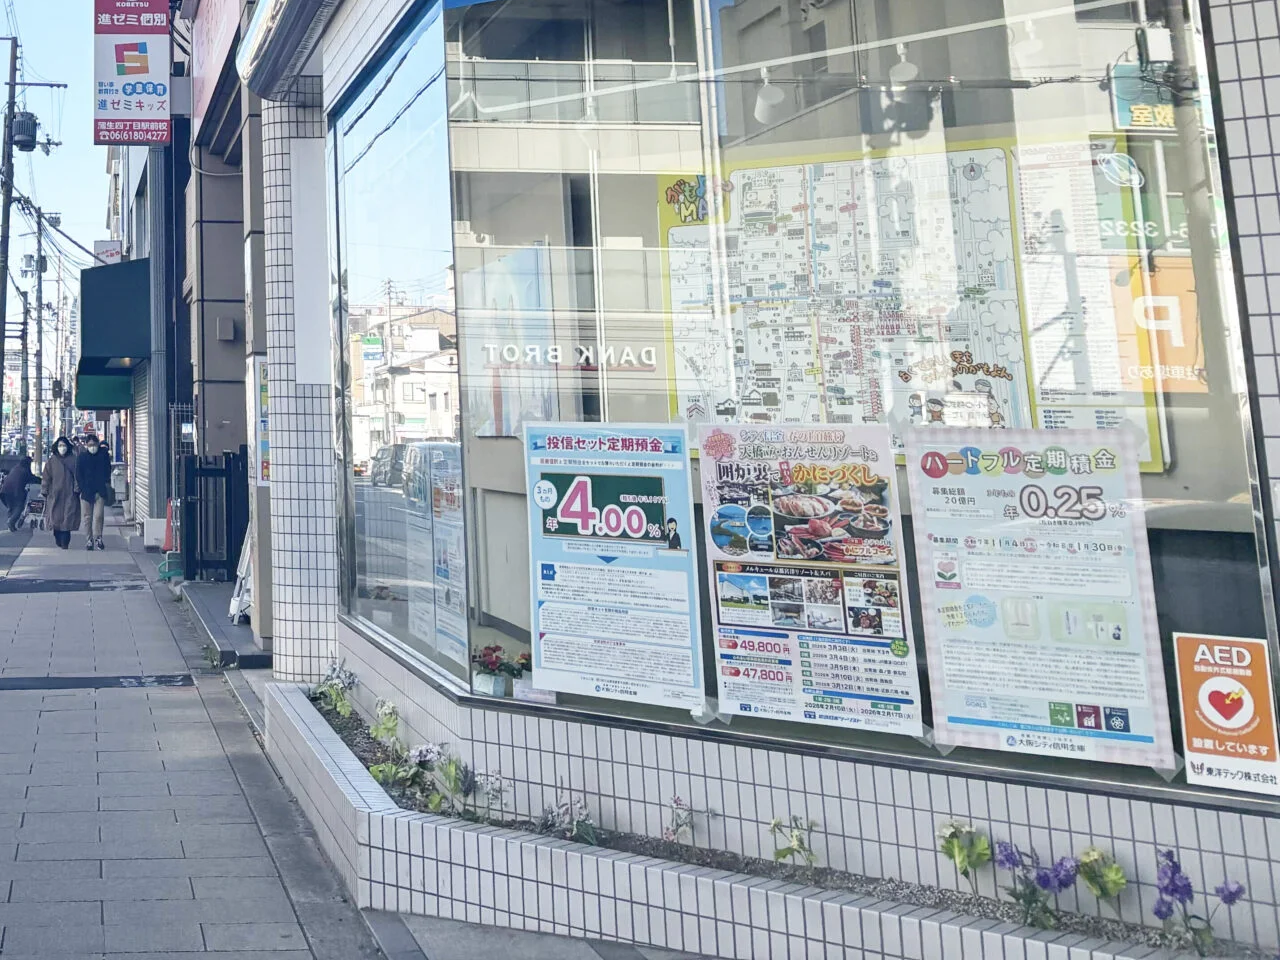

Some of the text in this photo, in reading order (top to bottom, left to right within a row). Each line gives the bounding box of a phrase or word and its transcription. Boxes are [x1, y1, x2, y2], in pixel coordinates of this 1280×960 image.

[97, 13, 167, 27] 進ゼミ個別
[97, 99, 167, 111] 進ゼミキッズ
[97, 121, 168, 130] 蒲生四丁目駅前校
[109, 131, 168, 141] 06(6180)4277
[546, 435, 664, 453] 投信セット定期預金
[738, 444, 878, 462] 天橋立・おんせんリゾートと
[925, 448, 1117, 475] ハートフル定期積金
[793, 464, 879, 486] かにづくし
[932, 487, 966, 497] 募集総額
[944, 496, 976, 506] 20億円
[546, 476, 661, 538] 年 4.00 %
[1003, 505, 1020, 520] 年
[1019, 484, 1108, 522] 0.25
[1194, 643, 1252, 667] AED
[1191, 737, 1270, 757] 設置しています
[1206, 766, 1279, 785] 東洋テック株式会社
